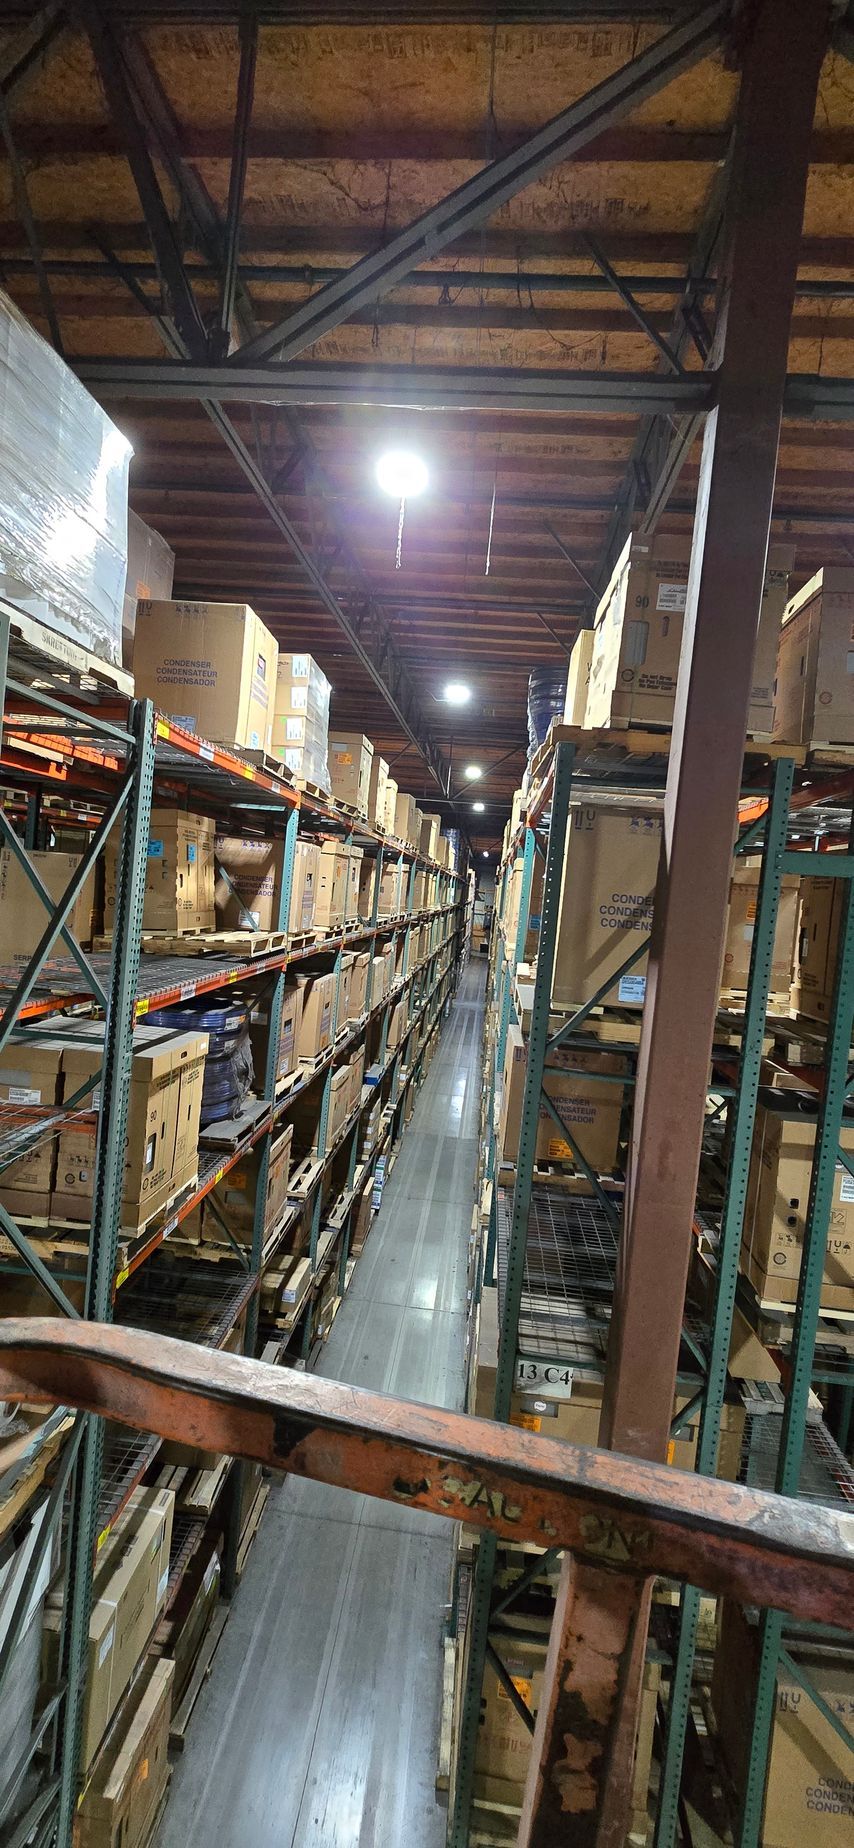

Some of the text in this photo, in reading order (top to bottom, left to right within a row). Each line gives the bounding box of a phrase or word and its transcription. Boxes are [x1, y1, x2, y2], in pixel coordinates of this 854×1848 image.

[635, 594, 649, 608] 90
[163, 659, 212, 669] CONDENSER
[156, 667, 218, 679] CONDENSATEUR
[157, 676, 216, 687] CONDENSADOR
[611, 893, 653, 906] CONDE
[600, 905, 654, 918] CONDENS
[600, 918, 653, 931] CONDENS
[149, 1110, 157, 1122] 90
[519, 1364, 573, 1385] 13 C4
[818, 1777, 854, 1791] COND
[805, 1787, 854, 1803] CONDEN
[807, 1800, 854, 1816] CONDEN
